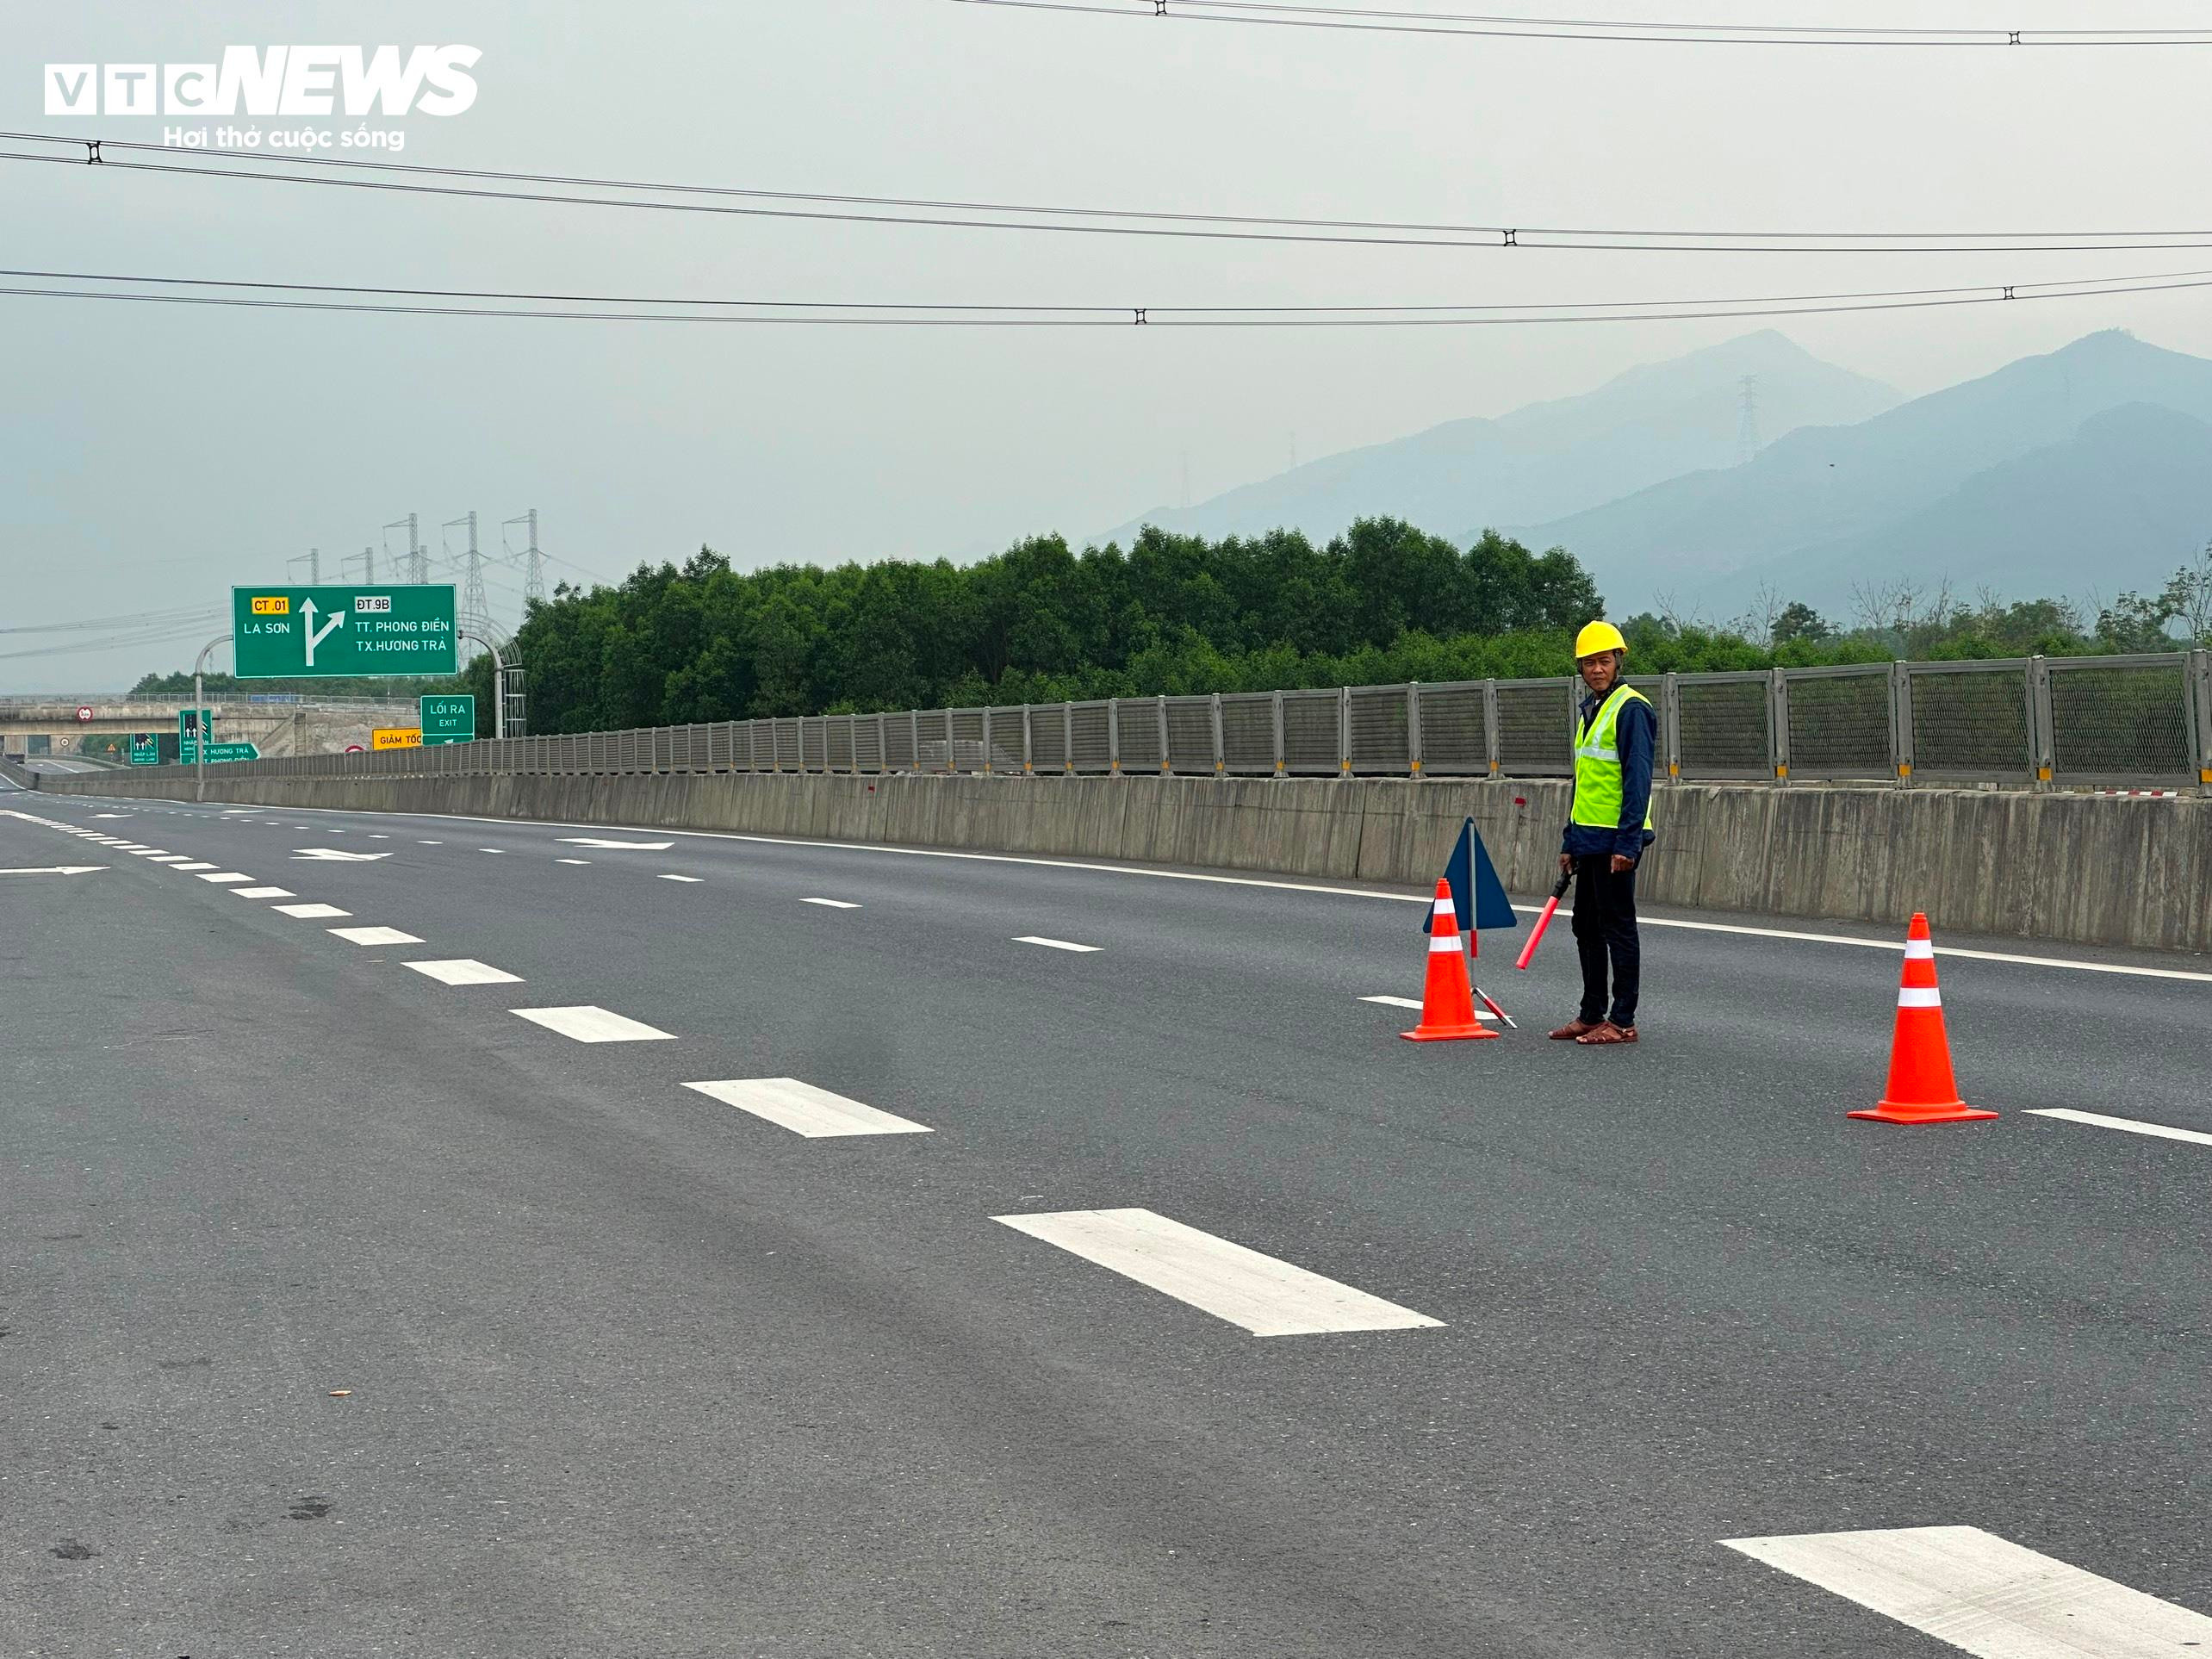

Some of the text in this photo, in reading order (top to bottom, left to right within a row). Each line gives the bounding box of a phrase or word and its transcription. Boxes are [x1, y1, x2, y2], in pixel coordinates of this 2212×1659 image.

[357, 600, 389, 610] ĐT.9B
[244, 622, 290, 634] LA SƠN
[355, 617, 450, 632] TT. PHONG ĐIỀN
[421, 636, 447, 650] TRÀ
[430, 700, 466, 714] LỐI RA
[380, 734, 402, 744] GIẢM
